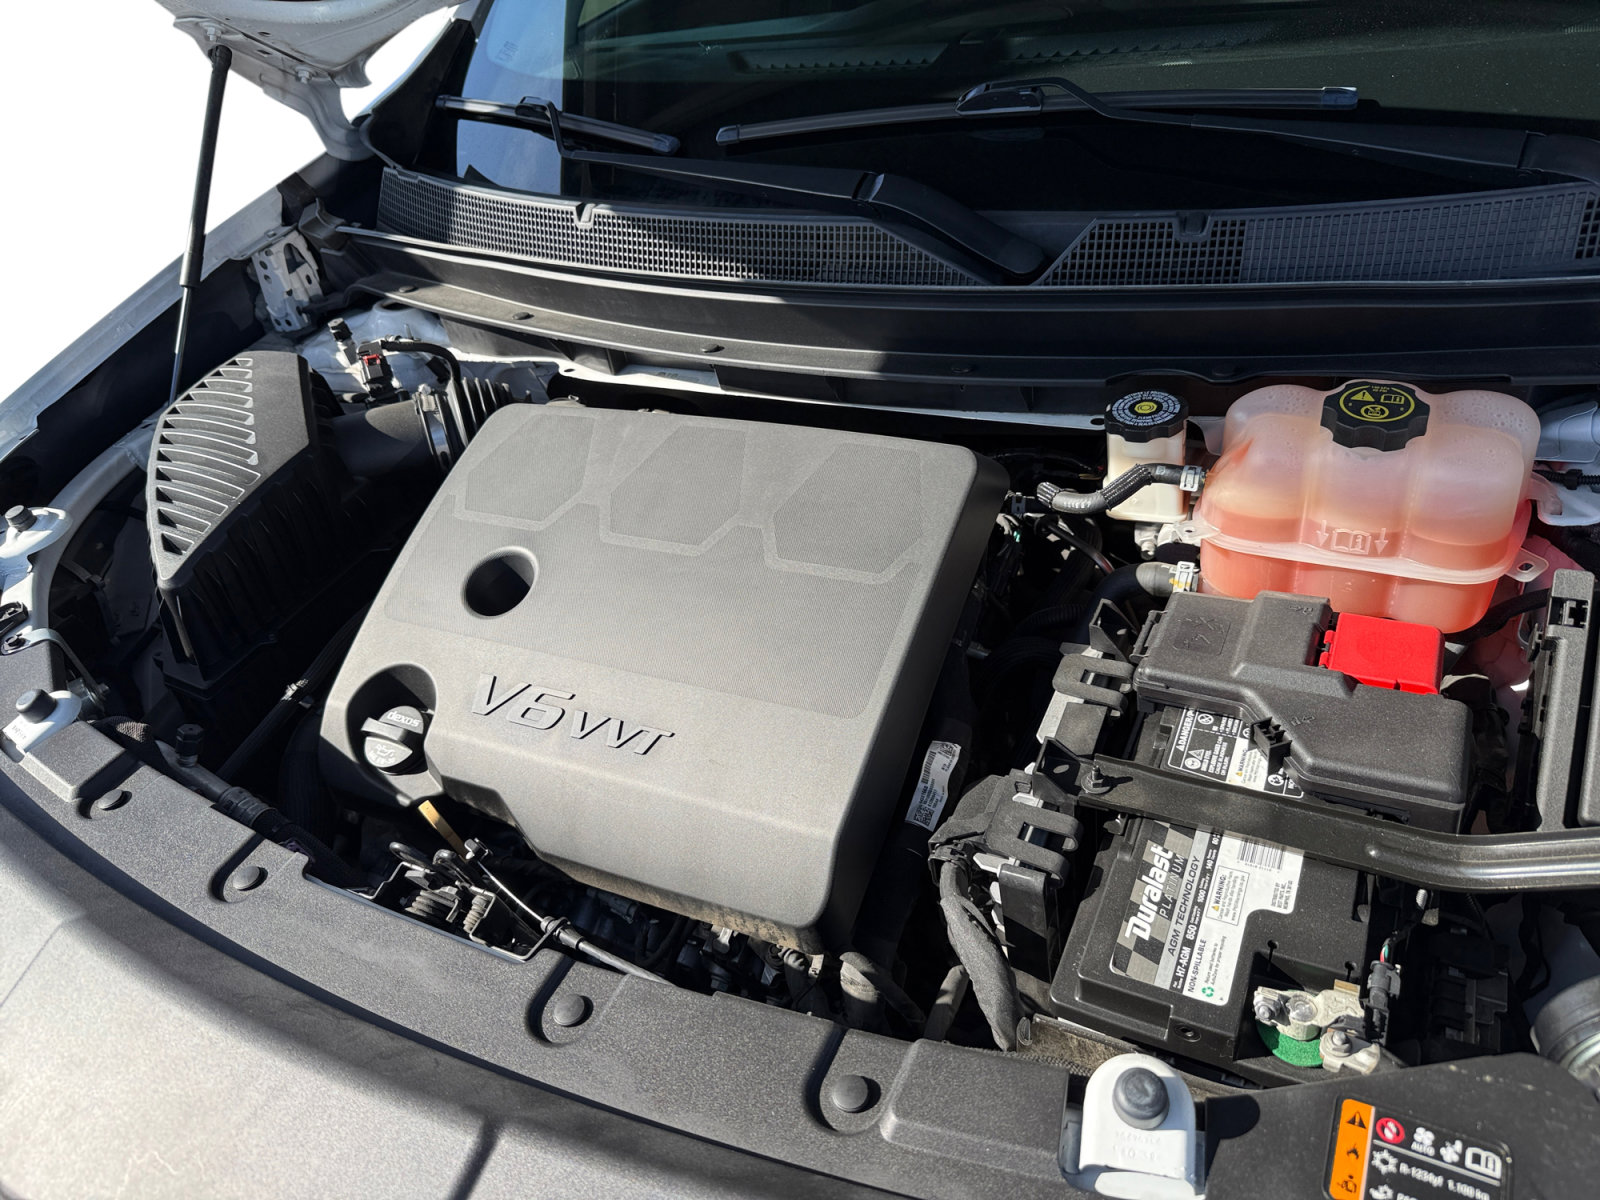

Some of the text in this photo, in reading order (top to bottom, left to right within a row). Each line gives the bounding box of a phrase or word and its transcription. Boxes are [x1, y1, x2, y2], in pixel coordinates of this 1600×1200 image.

[387, 711, 421, 726] dexos
[570, 710, 675, 756] VVT
[1125, 845, 1173, 940] Duralast
[1160, 855, 1186, 918] PLATINUM
[1197, 889, 1206, 902] 1000
[1214, 875, 1226, 904] WARNING:
[1168, 856, 1200, 956] AGM TECHNOLOGY
[1186, 924, 1197, 940] 850
[1175, 946, 1191, 977] H7-AGM
[1187, 939, 1207, 993] NON-SPILLABLE
[1411, 1142, 1435, 1156] AUTO
